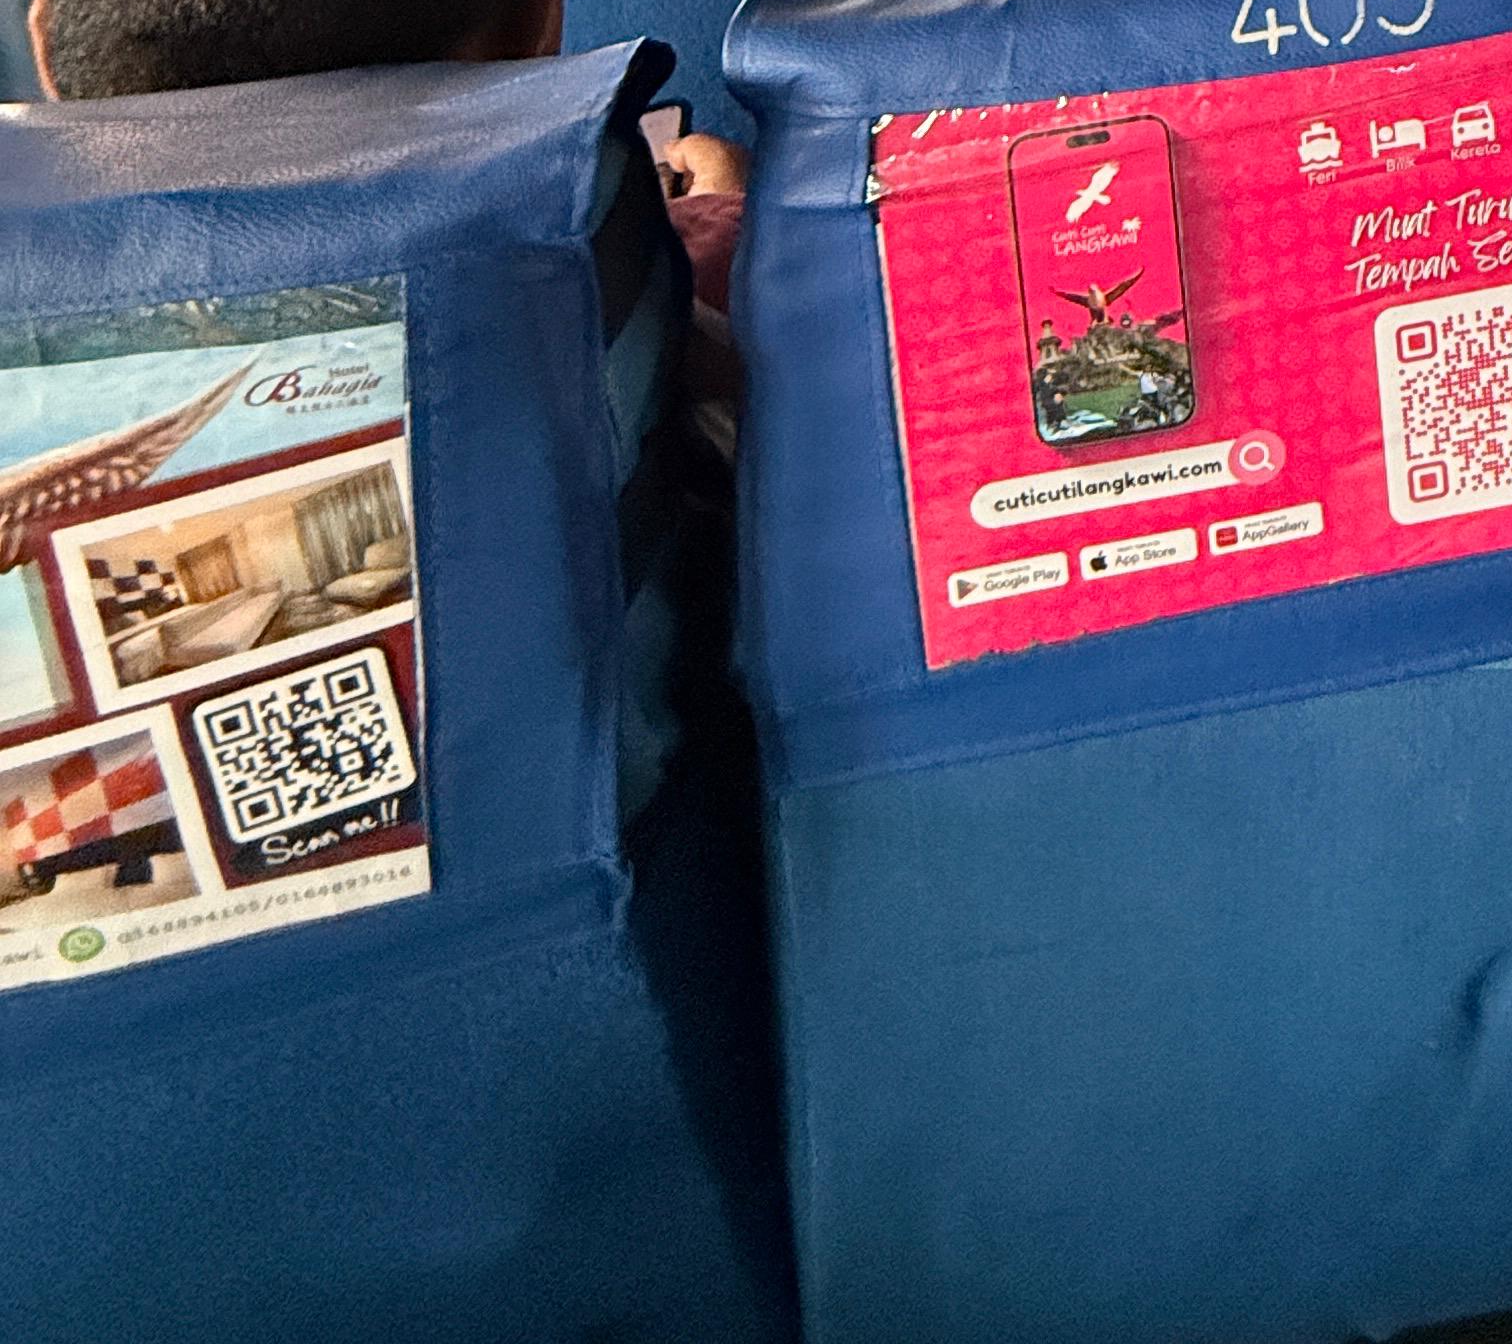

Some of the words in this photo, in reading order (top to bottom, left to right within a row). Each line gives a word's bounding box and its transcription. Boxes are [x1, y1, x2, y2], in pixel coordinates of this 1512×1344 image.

[1307, 170, 1337, 186] Feri
[1450, 142, 1502, 161] Kereta
[1053, 232, 1139, 257] LANGKAWI
[1350, 199, 1439, 248] Muat
[1343, 242, 1462, 296] Tempah
[244, 365, 388, 407] Bahagia
[992, 458, 1224, 515] cuticutilangkawi.com
[1114, 552, 1140, 568] App
[1143, 544, 1178, 562] Store
[983, 574, 1031, 593] Google
[1032, 568, 1062, 582] Play
[260, 828, 341, 866] Scan
